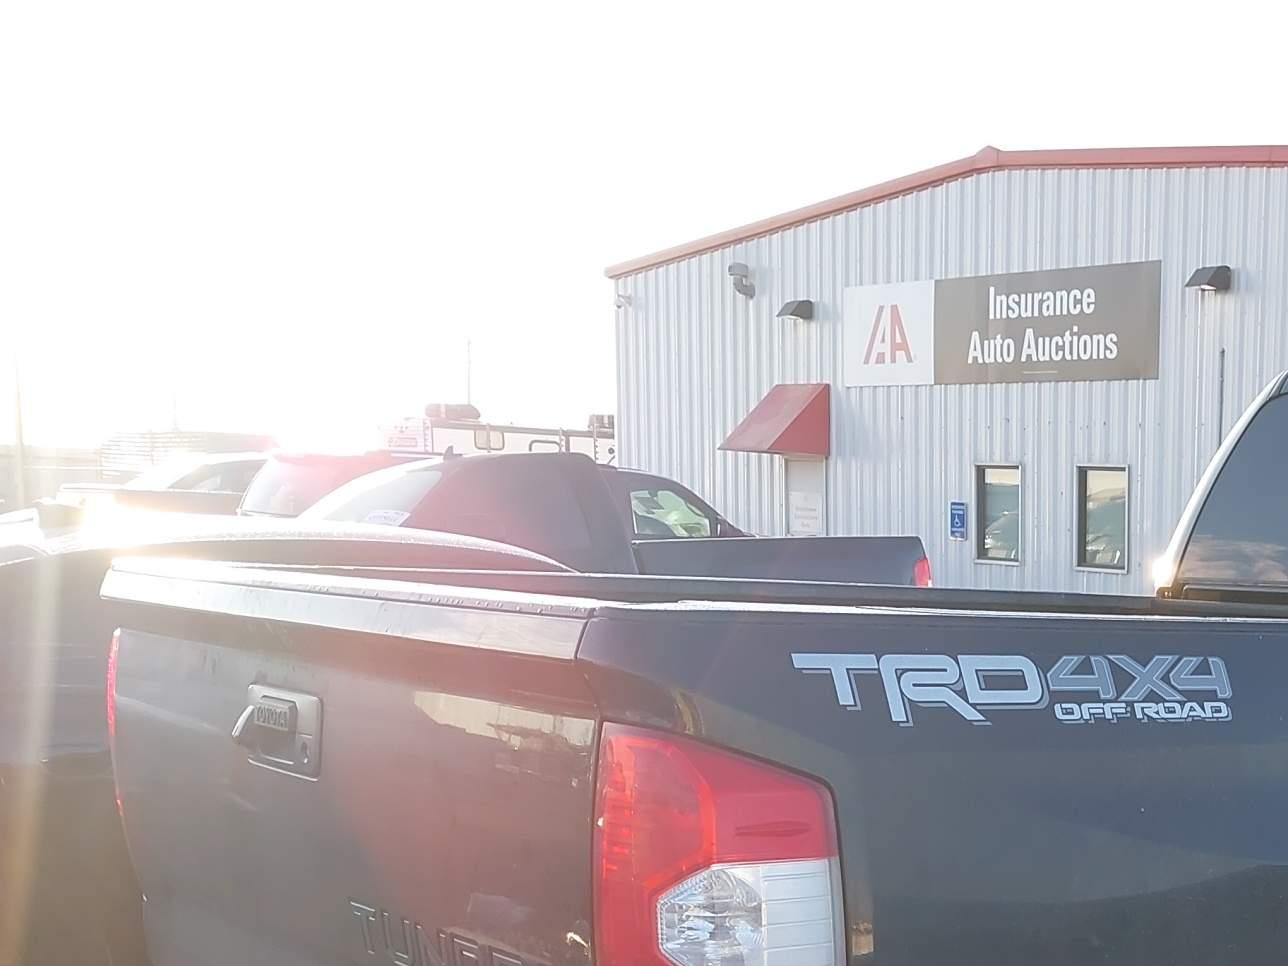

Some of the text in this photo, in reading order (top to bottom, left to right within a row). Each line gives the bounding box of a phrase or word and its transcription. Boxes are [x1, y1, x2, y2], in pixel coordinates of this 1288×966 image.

[989, 286, 1096, 320] Insurance
[967, 325, 1118, 364] Auto Auctions
[791, 653, 1048, 725] TRD
[255, 704, 288, 730] TOYOTA
[1054, 701, 1231, 723] OFF ROAD
